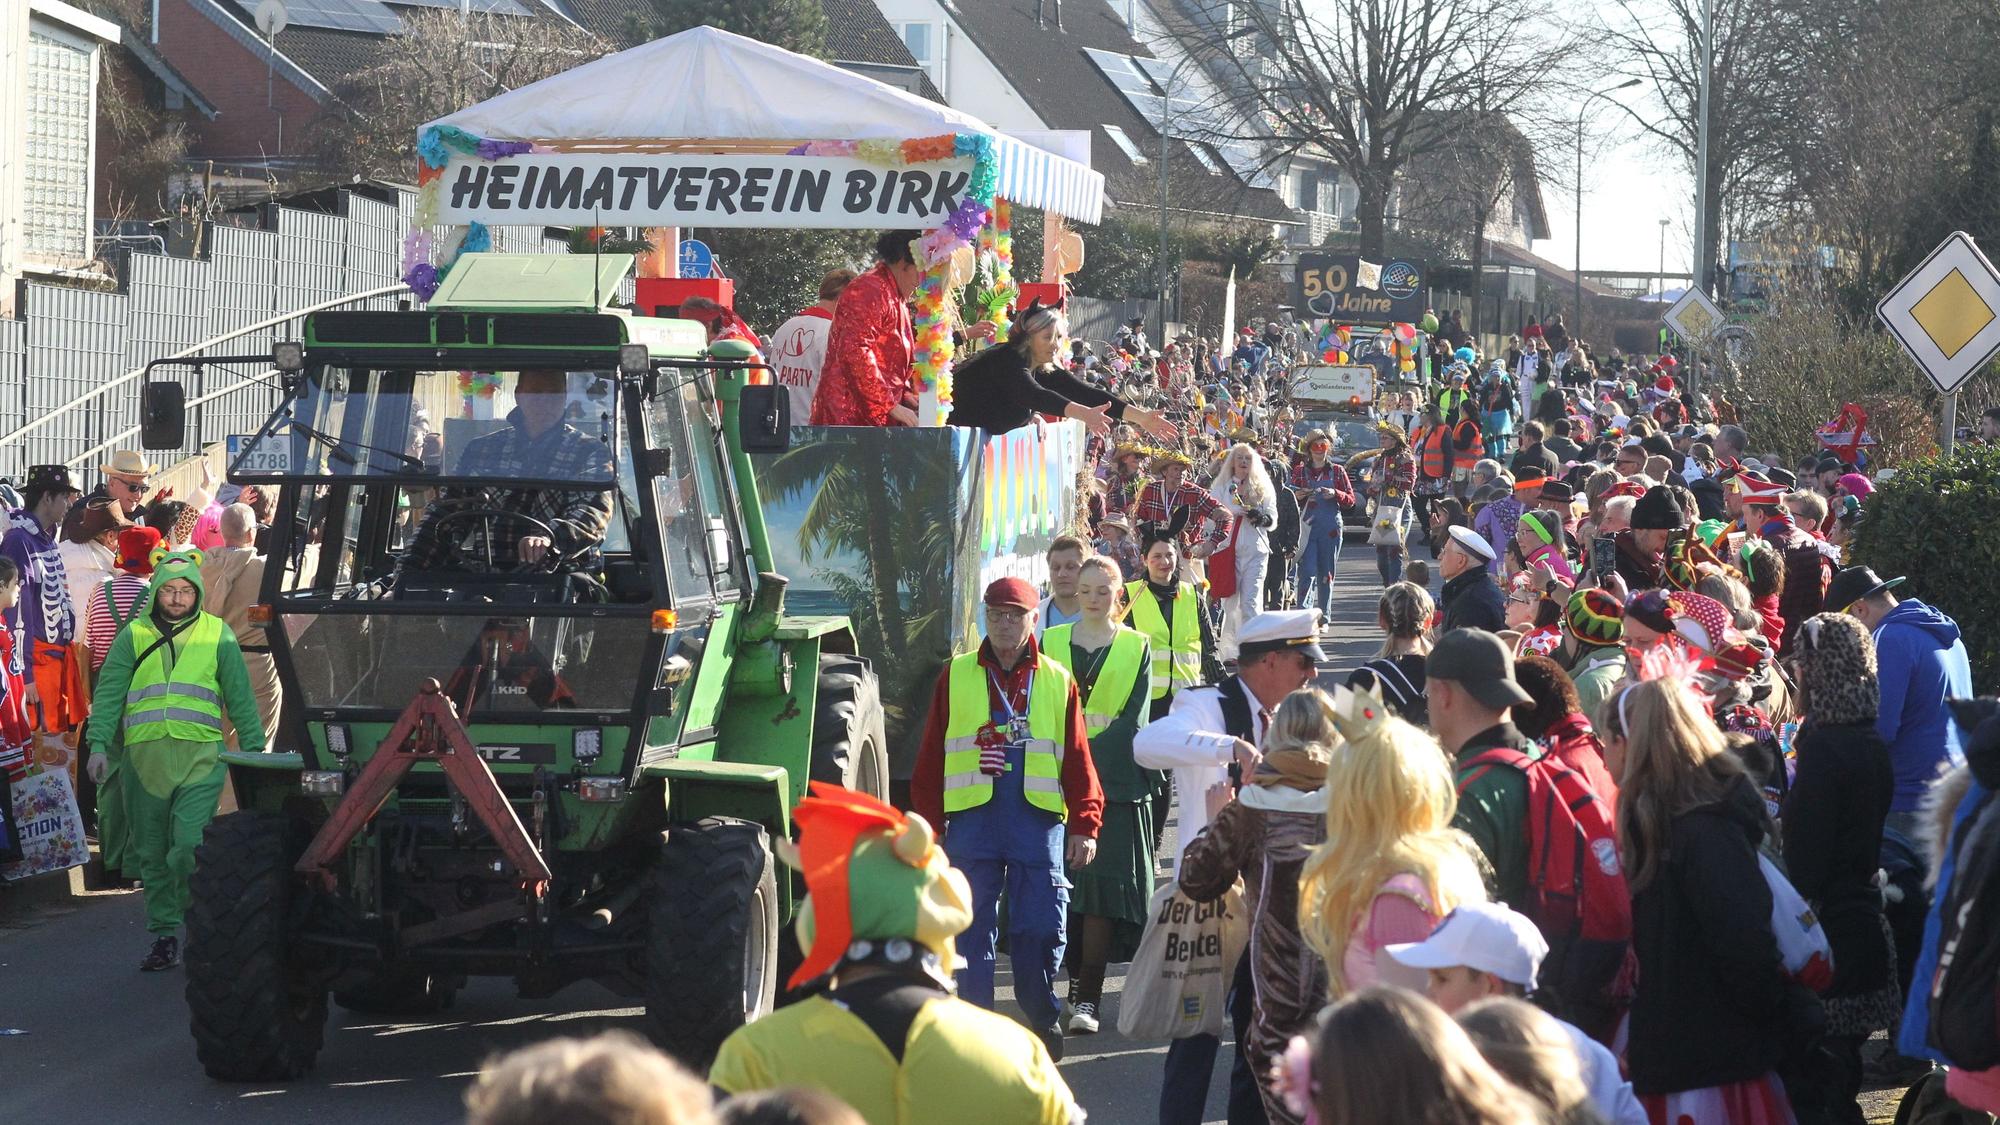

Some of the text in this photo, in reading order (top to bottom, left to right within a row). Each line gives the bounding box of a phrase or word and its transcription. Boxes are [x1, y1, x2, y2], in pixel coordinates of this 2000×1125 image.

[451, 165, 969, 218] HEIMATVEREIN BIRK
[1303, 265, 1347, 296] 50
[1337, 293, 1391, 313] Jahre
[780, 365, 812, 388] PARTY
[499, 686, 527, 695] KHD
[17, 815, 62, 840] CTION
[1157, 896, 1193, 925] Der
